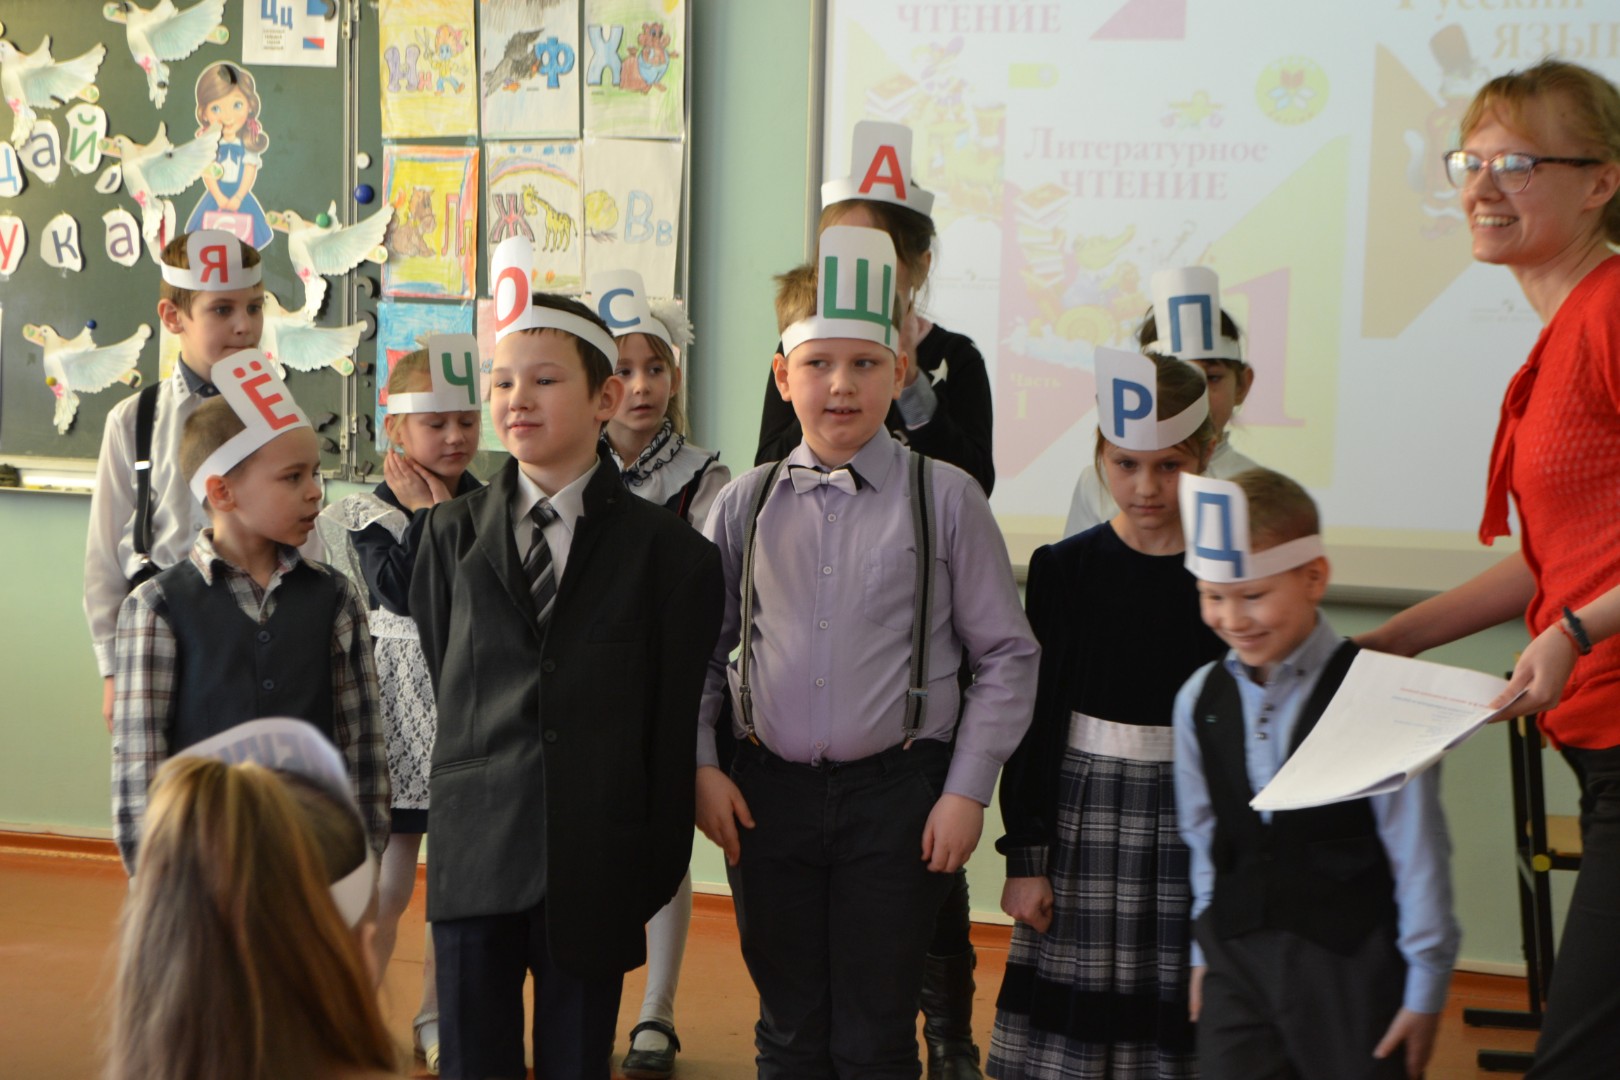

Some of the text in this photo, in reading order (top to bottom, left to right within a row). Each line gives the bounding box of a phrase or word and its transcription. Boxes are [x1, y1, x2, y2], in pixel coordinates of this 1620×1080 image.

[897, 2, 1062, 34] ЧТЕНИЕ
[535, 36, 575, 89] Ф
[586, 24, 624, 87] Х
[858, 144, 907, 201] А
[1023, 124, 1269, 168] Литературное
[1059, 170, 1229, 201] ЧТЕНИЕ
[199, 244, 229, 284] Я
[495, 266, 529, 332] О
[598, 287, 641, 329] С
[823, 255, 893, 346] Щ
[1168, 294, 1214, 353] П
[232, 360, 300, 431] Ё
[441, 351, 476, 405] Ч
[1112, 377, 1154, 439] Р
[1193, 490, 1246, 579] Д
